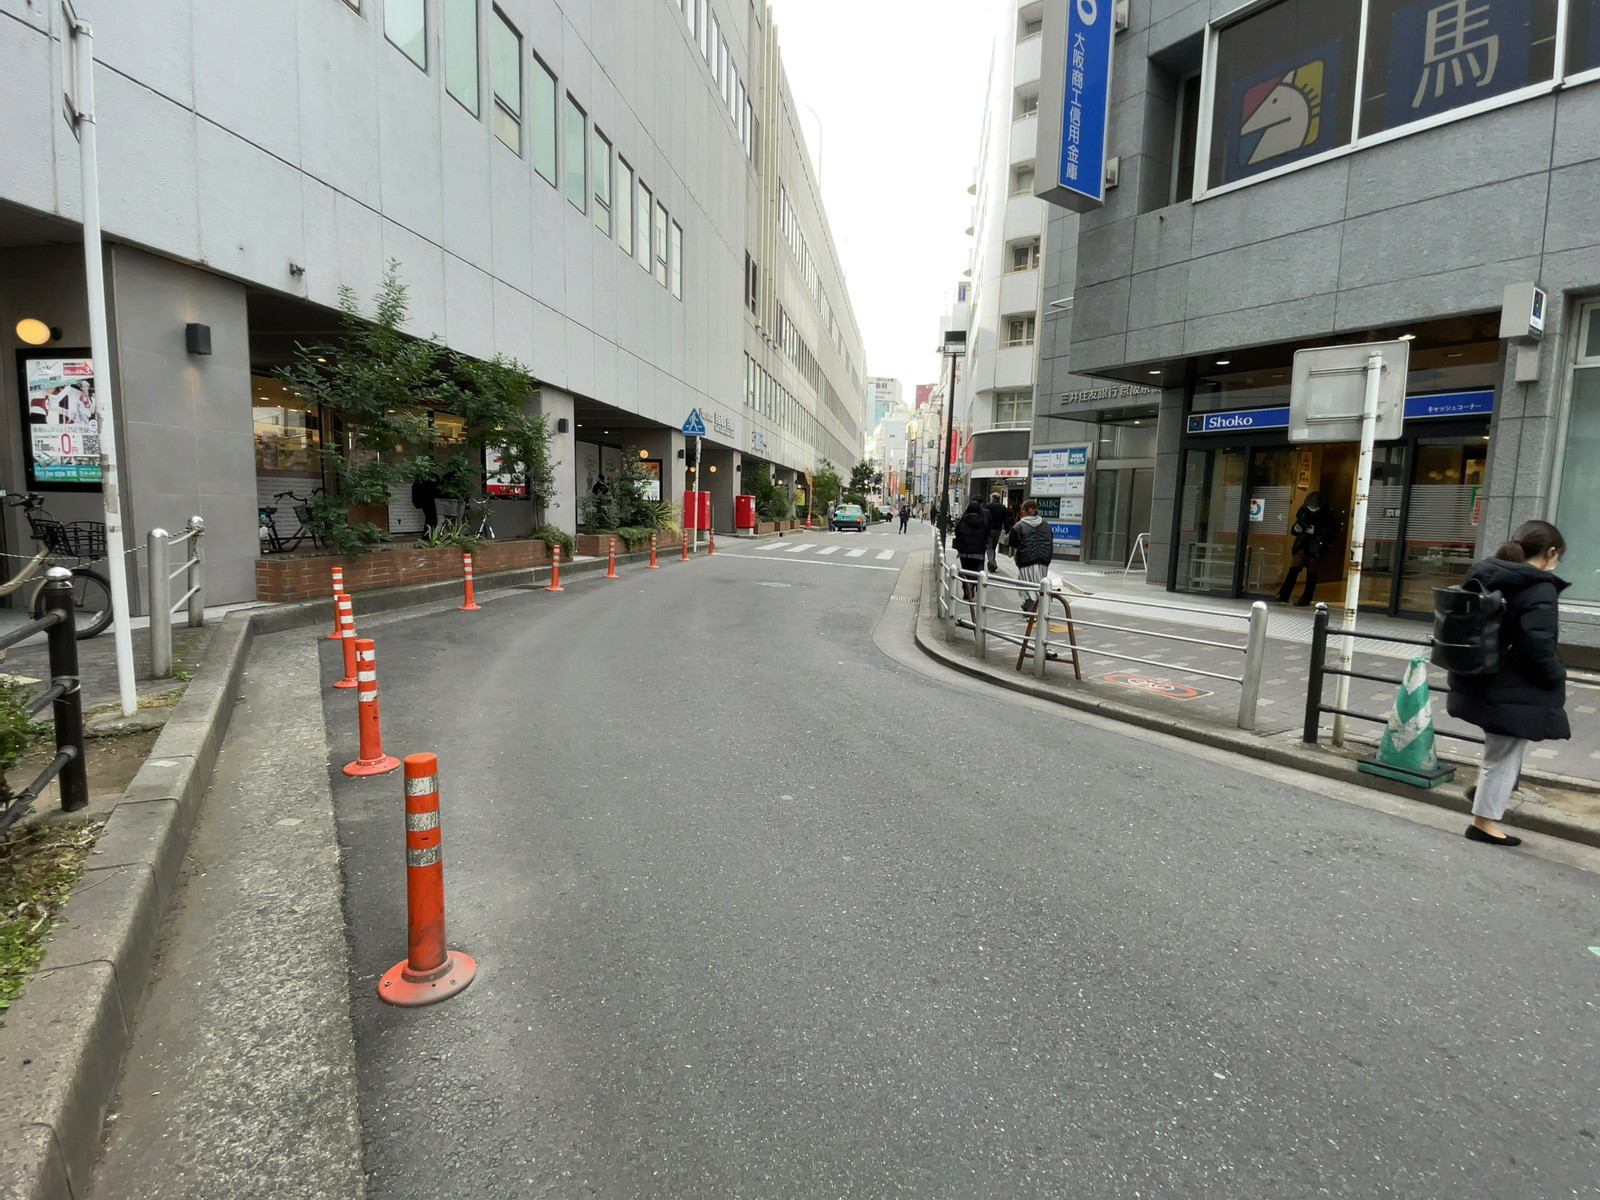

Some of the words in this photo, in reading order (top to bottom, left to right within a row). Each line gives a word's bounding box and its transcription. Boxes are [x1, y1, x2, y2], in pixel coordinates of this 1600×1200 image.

[1411, 0, 1499, 108] 馬
[1065, 31, 1086, 181] 大阪商工信用金庫
[1061, 384, 1119, 405] 三井住友銀行
[1426, 403, 1481, 413] キャッシュコーナー
[1208, 415, 1253, 429] Shoko
[1038, 499, 1059, 508] SMBC
[1051, 525, 1069, 534] oko
